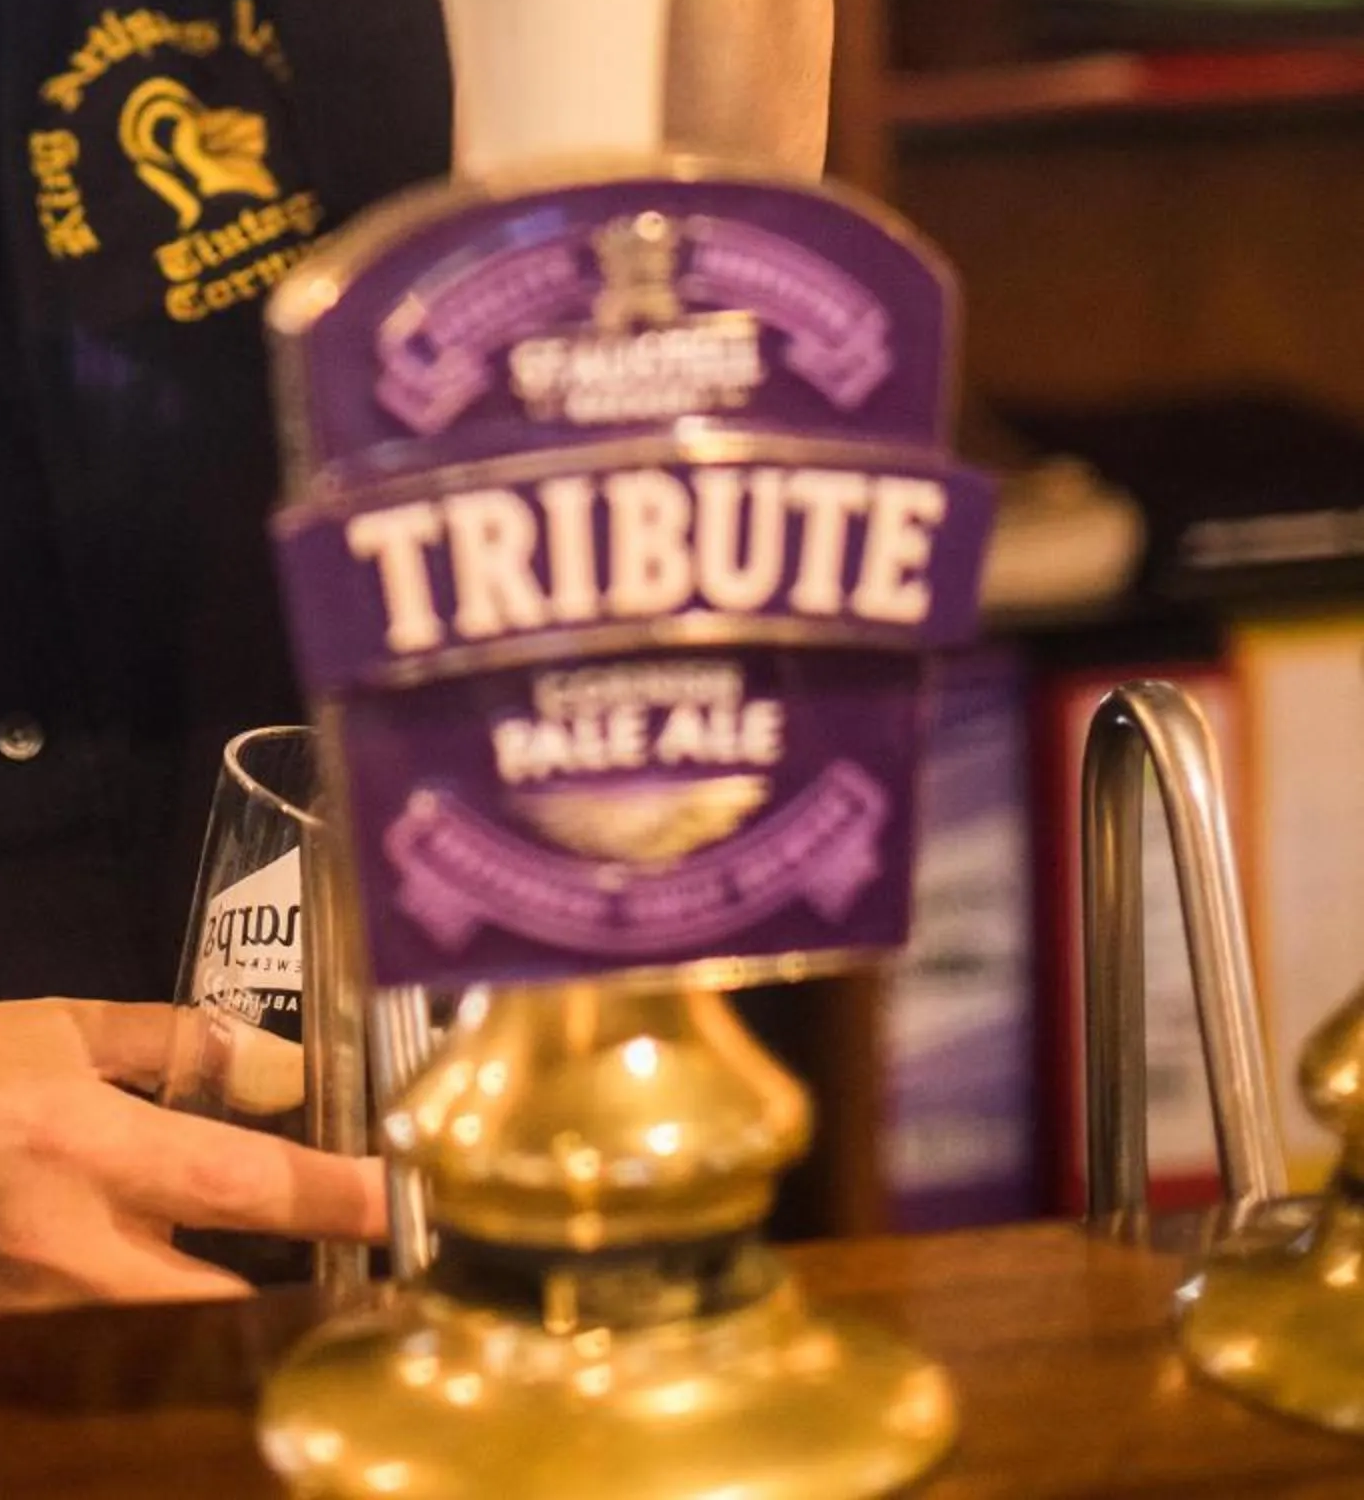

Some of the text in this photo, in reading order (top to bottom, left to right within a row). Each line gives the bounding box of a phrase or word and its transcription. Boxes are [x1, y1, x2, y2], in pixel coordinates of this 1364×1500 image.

[165, 248, 302, 322] Corn
[346, 466, 948, 654] TRIBUTE
[493, 698, 783, 784] PALE ALE
